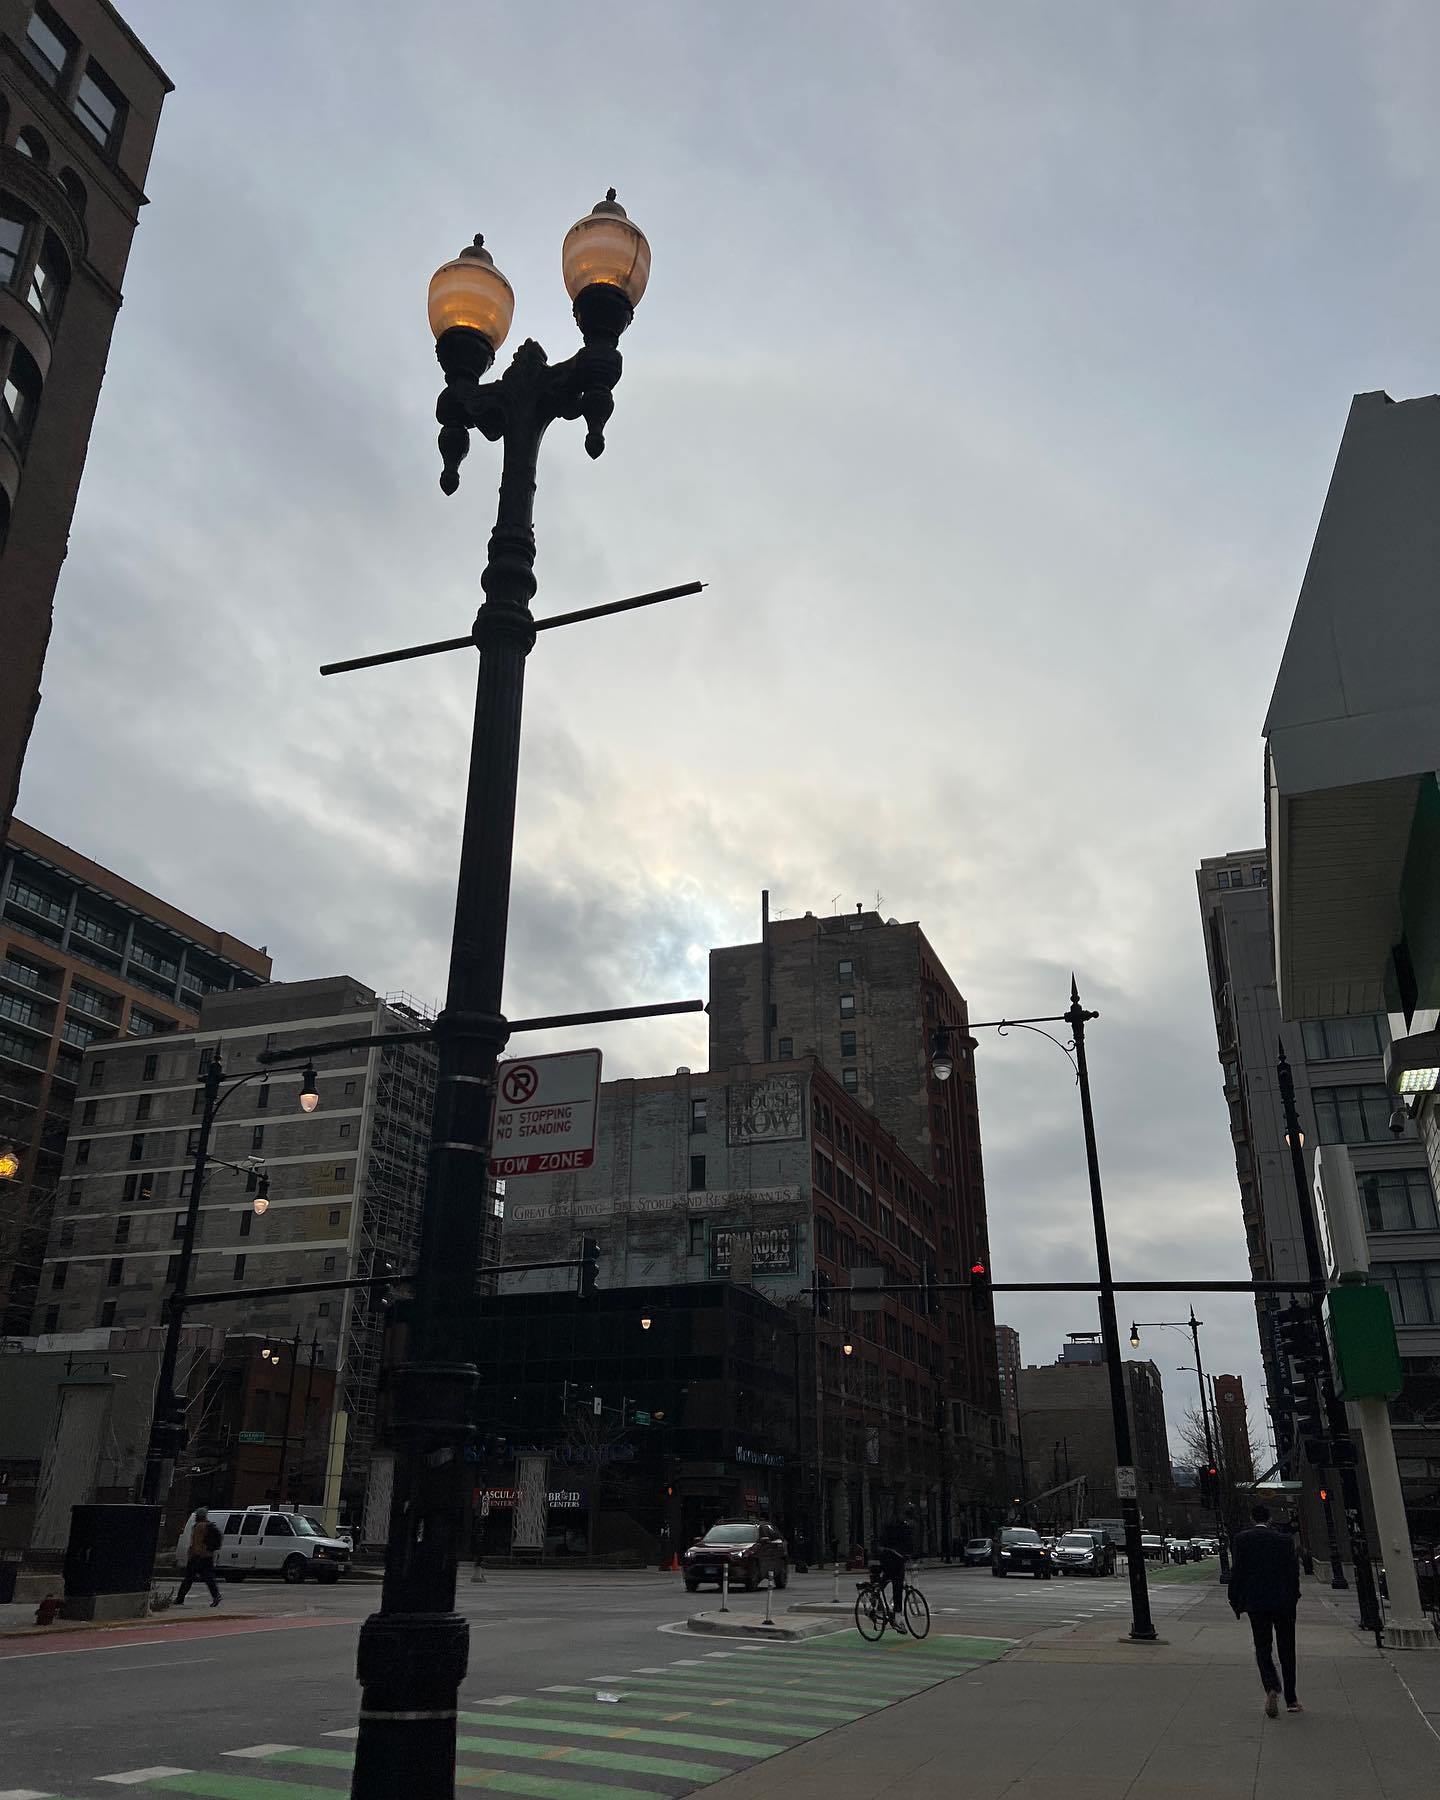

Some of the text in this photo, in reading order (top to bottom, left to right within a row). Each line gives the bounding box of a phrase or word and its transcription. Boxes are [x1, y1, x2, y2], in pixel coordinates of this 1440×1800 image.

[497, 1107, 573, 1126] NO STOPPING
[736, 1110, 797, 1135] ROW
[496, 1121, 572, 1139] NO STANDING
[495, 1151, 585, 1174] TOW ZONE
[514, 1205, 546, 1220] GREAT
